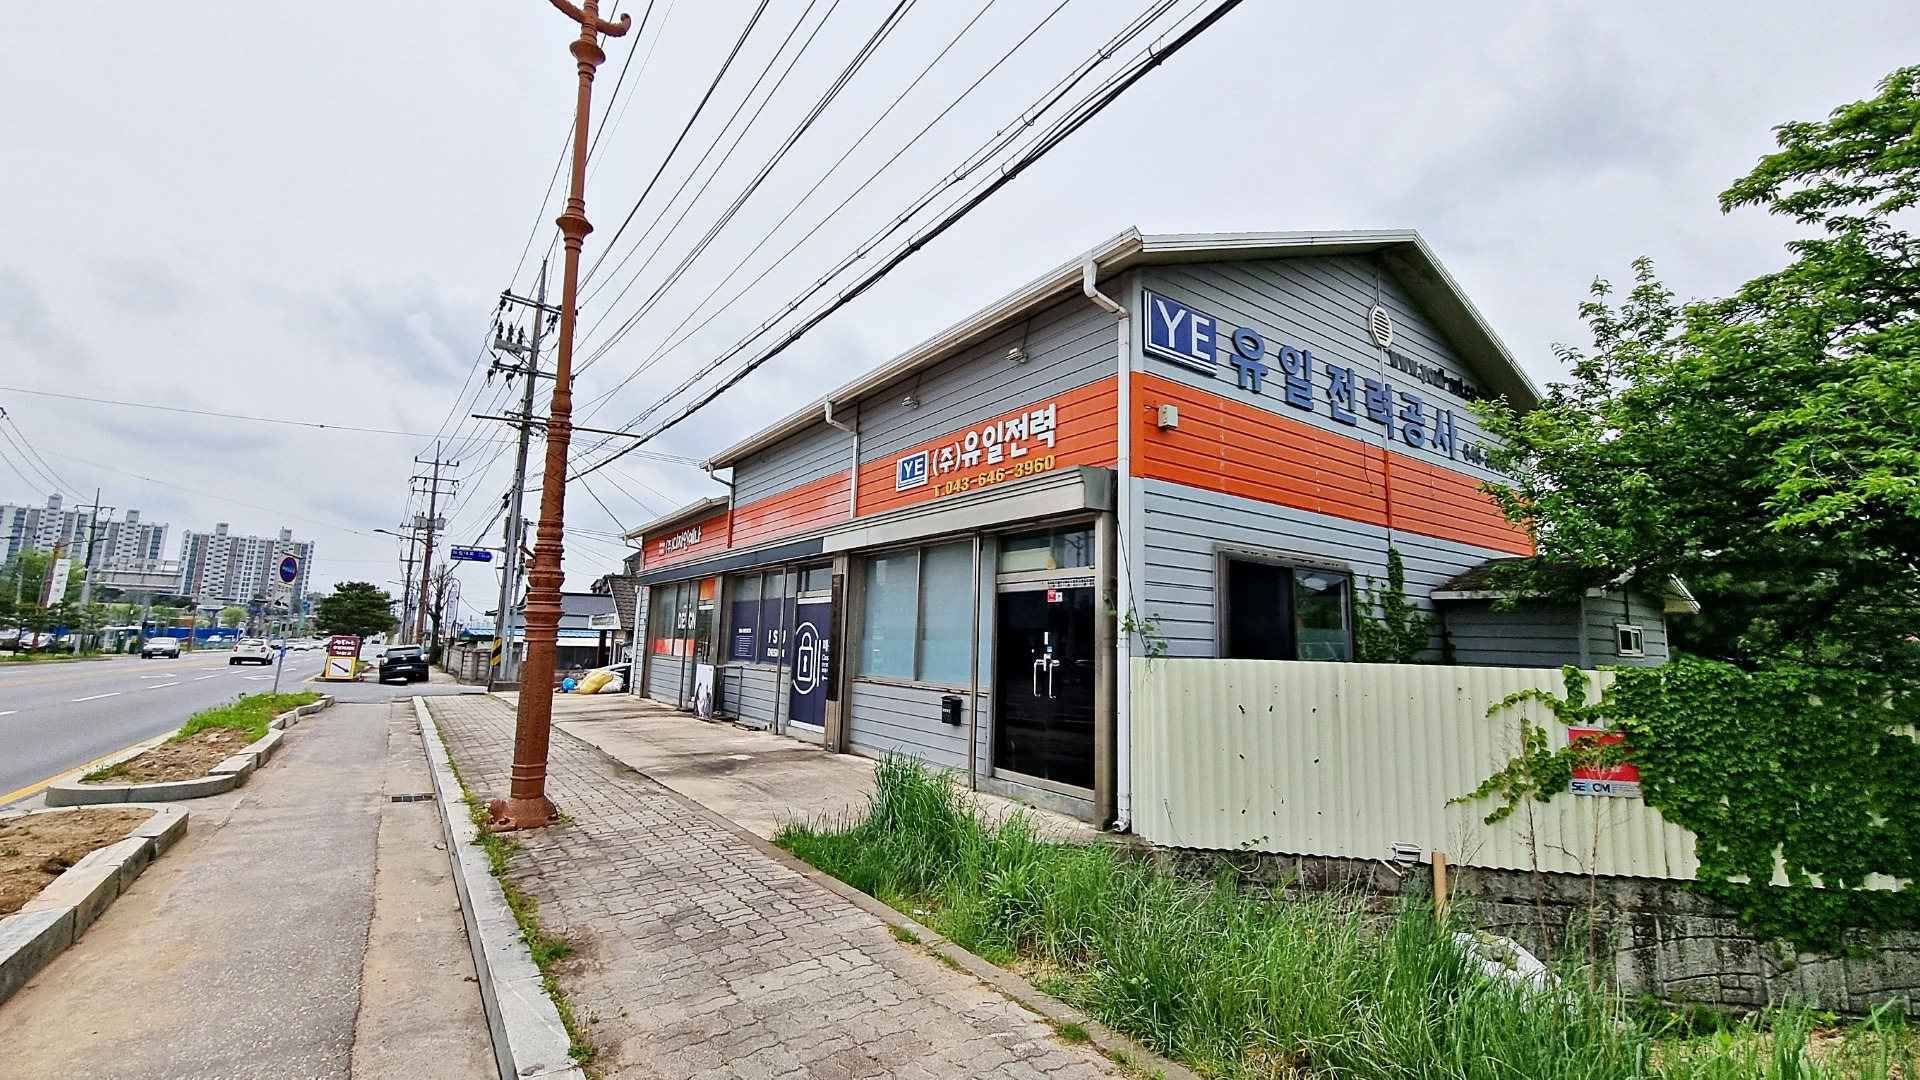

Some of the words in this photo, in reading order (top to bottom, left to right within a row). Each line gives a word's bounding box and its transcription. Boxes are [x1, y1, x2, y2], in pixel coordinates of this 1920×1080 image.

[1156, 299, 1211, 361] YE
[1230, 327, 1458, 460] 유일전력공사
[932, 403, 1057, 476] (주)유일전력
[903, 458, 924, 479] YE
[933, 455, 1055, 498] T.043-646-3960
[677, 612, 696, 630] DEGN
